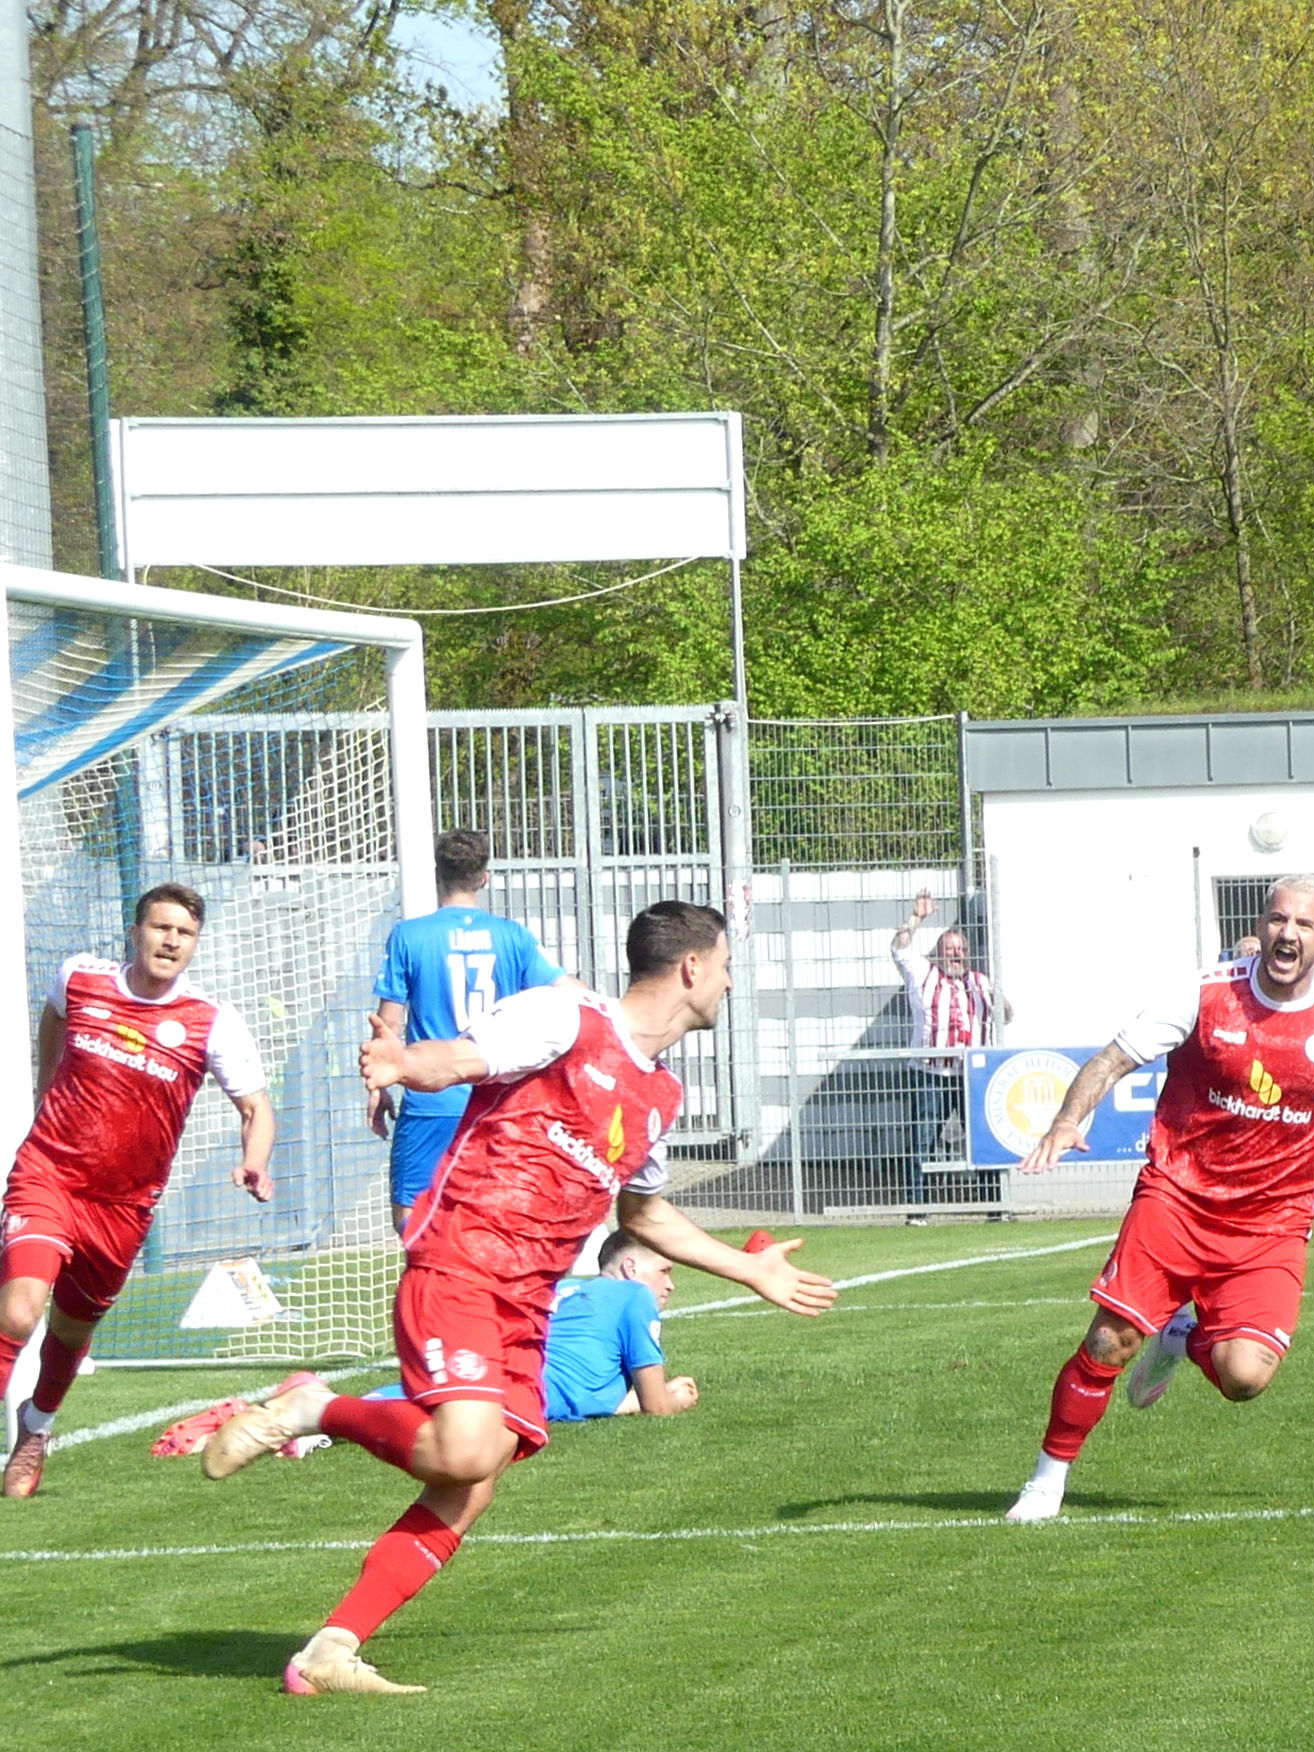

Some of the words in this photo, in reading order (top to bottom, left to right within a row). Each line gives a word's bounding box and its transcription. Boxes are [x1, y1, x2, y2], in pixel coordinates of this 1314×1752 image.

[447, 954, 497, 1032] 13
[146, 1058, 179, 1082] bau
[1209, 1087, 1281, 1121] bickhardt
[1282, 1105, 1312, 1124] bau
